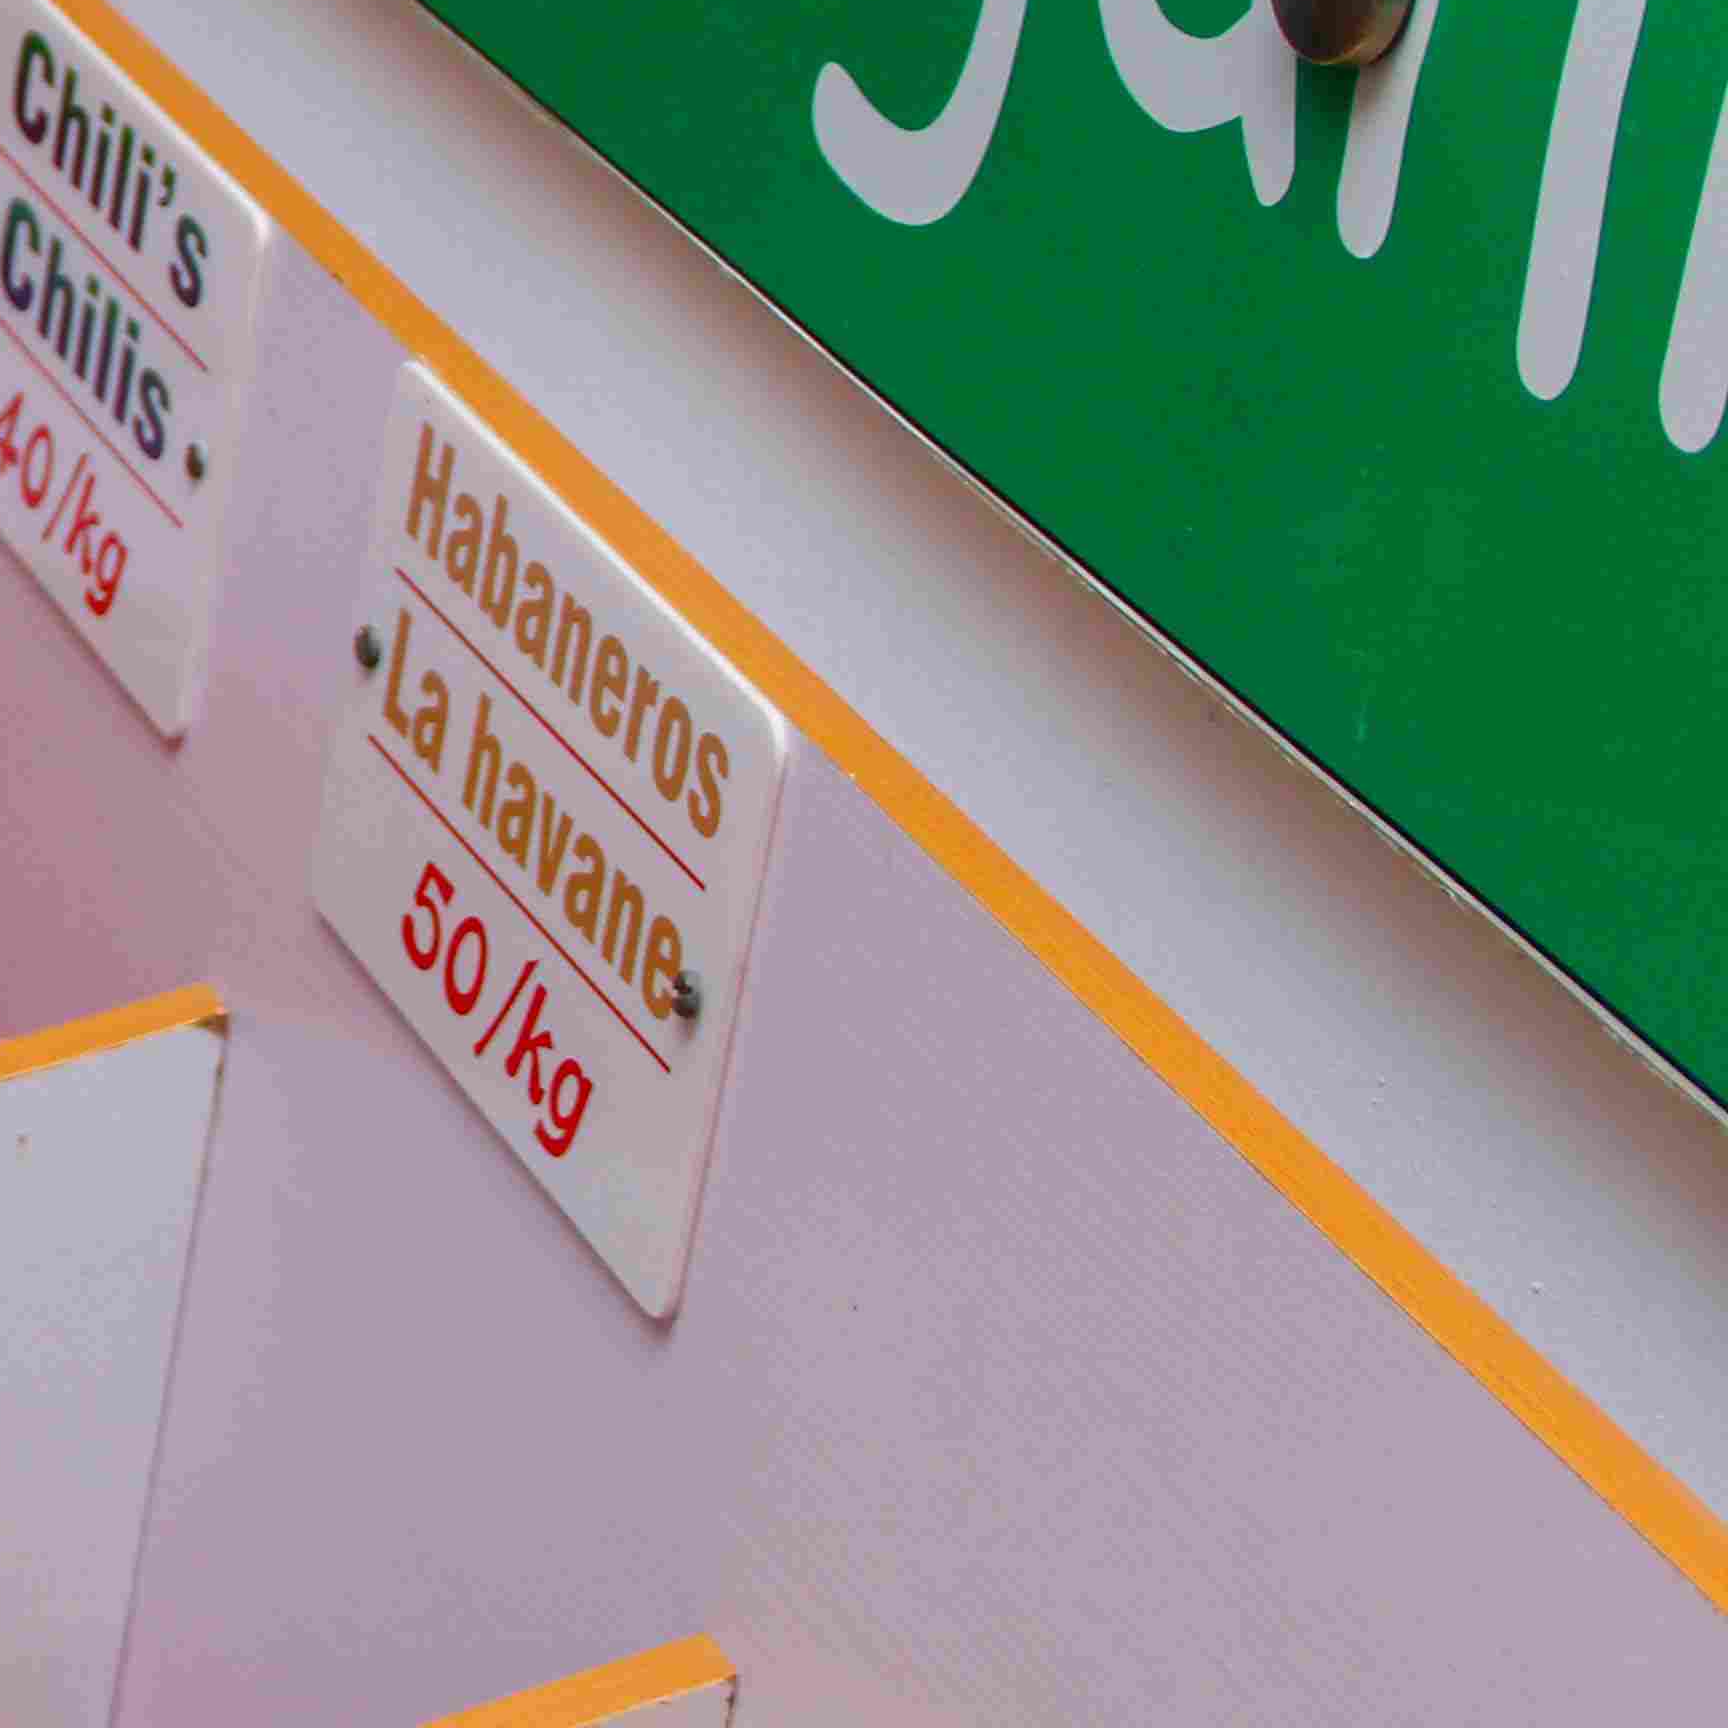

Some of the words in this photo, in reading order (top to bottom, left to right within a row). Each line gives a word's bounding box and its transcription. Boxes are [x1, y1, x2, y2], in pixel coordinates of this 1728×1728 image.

[12, 29, 208, 310] Chili's
[404, 421, 732, 842] Habaneros
[382, 606, 450, 776] La
[461, 690, 685, 1024] havane
[401, 861, 594, 1158] 50/kg
